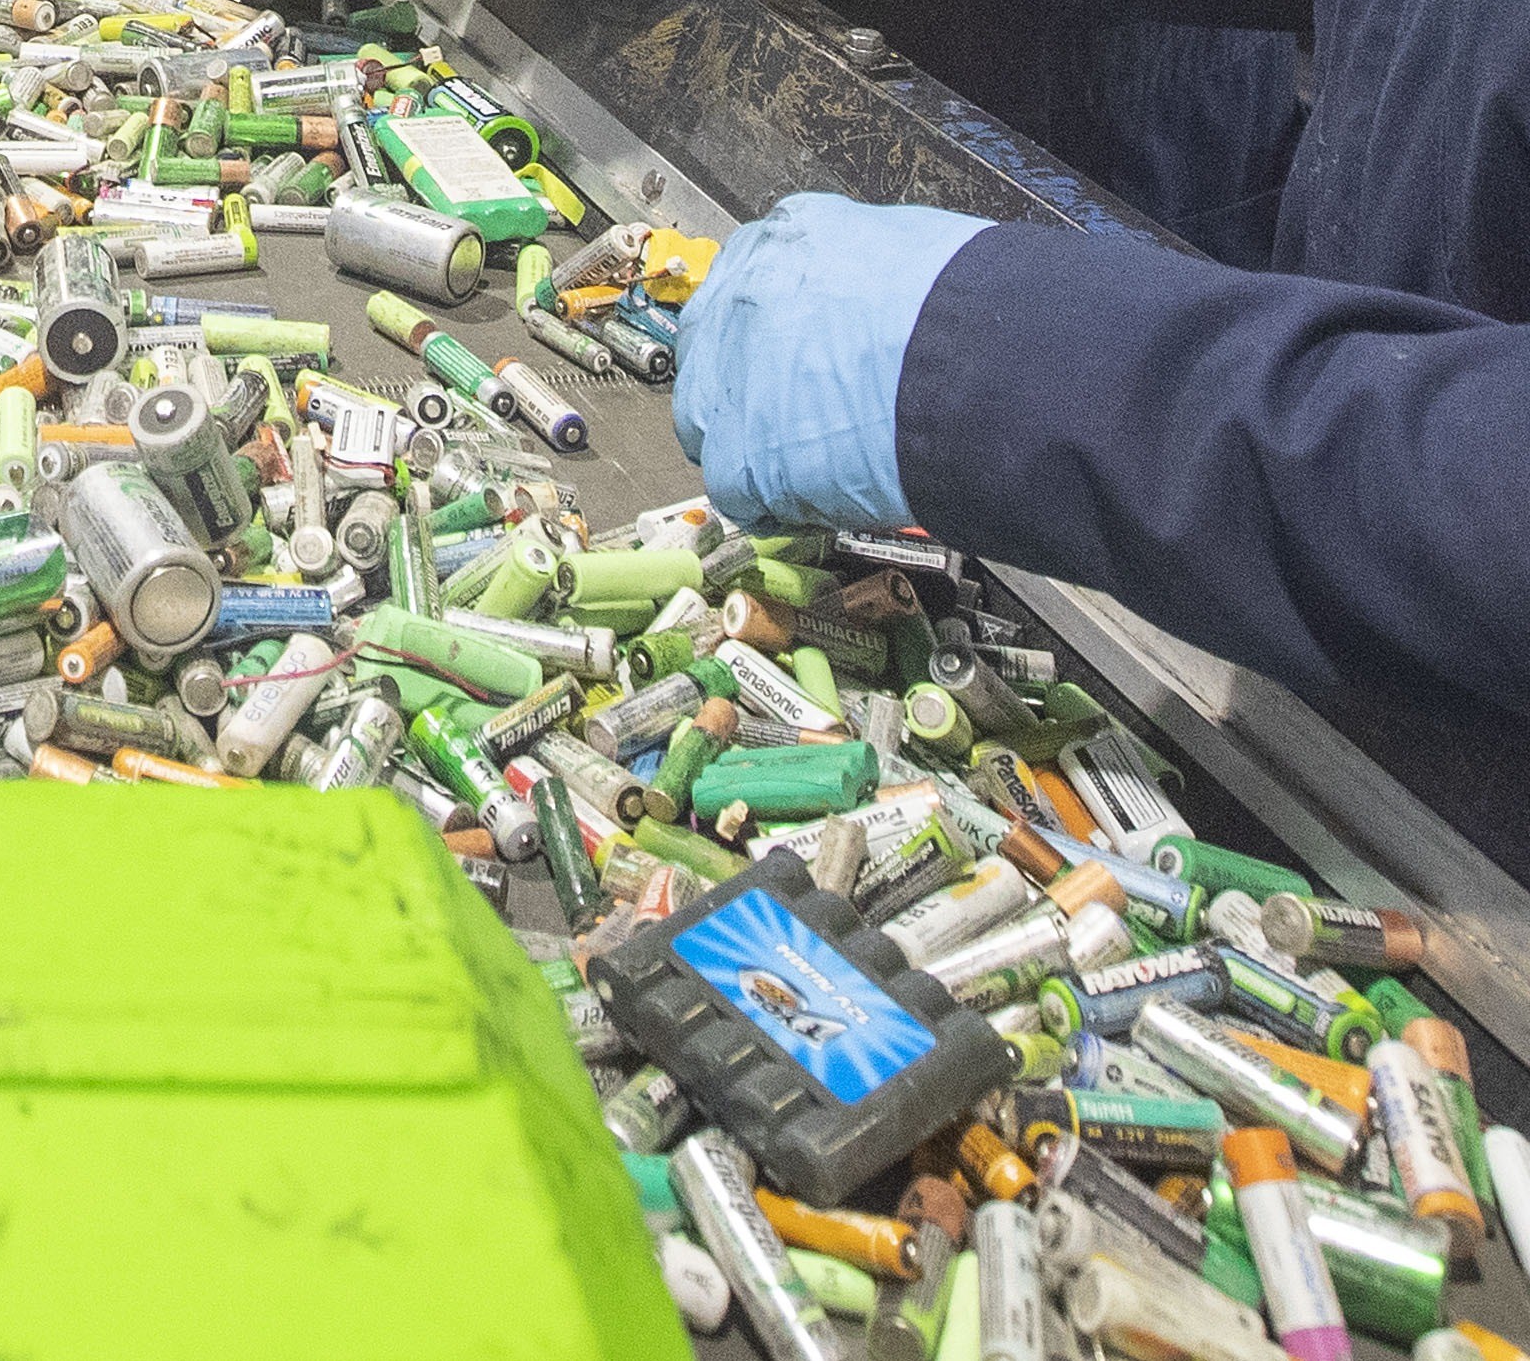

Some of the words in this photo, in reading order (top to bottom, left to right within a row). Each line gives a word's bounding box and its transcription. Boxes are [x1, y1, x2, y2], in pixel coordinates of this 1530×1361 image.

[729, 657, 804, 721] Panasonic
[500, 695, 573, 751] Energizer
[1080, 945, 1204, 997] RAYOVAC
